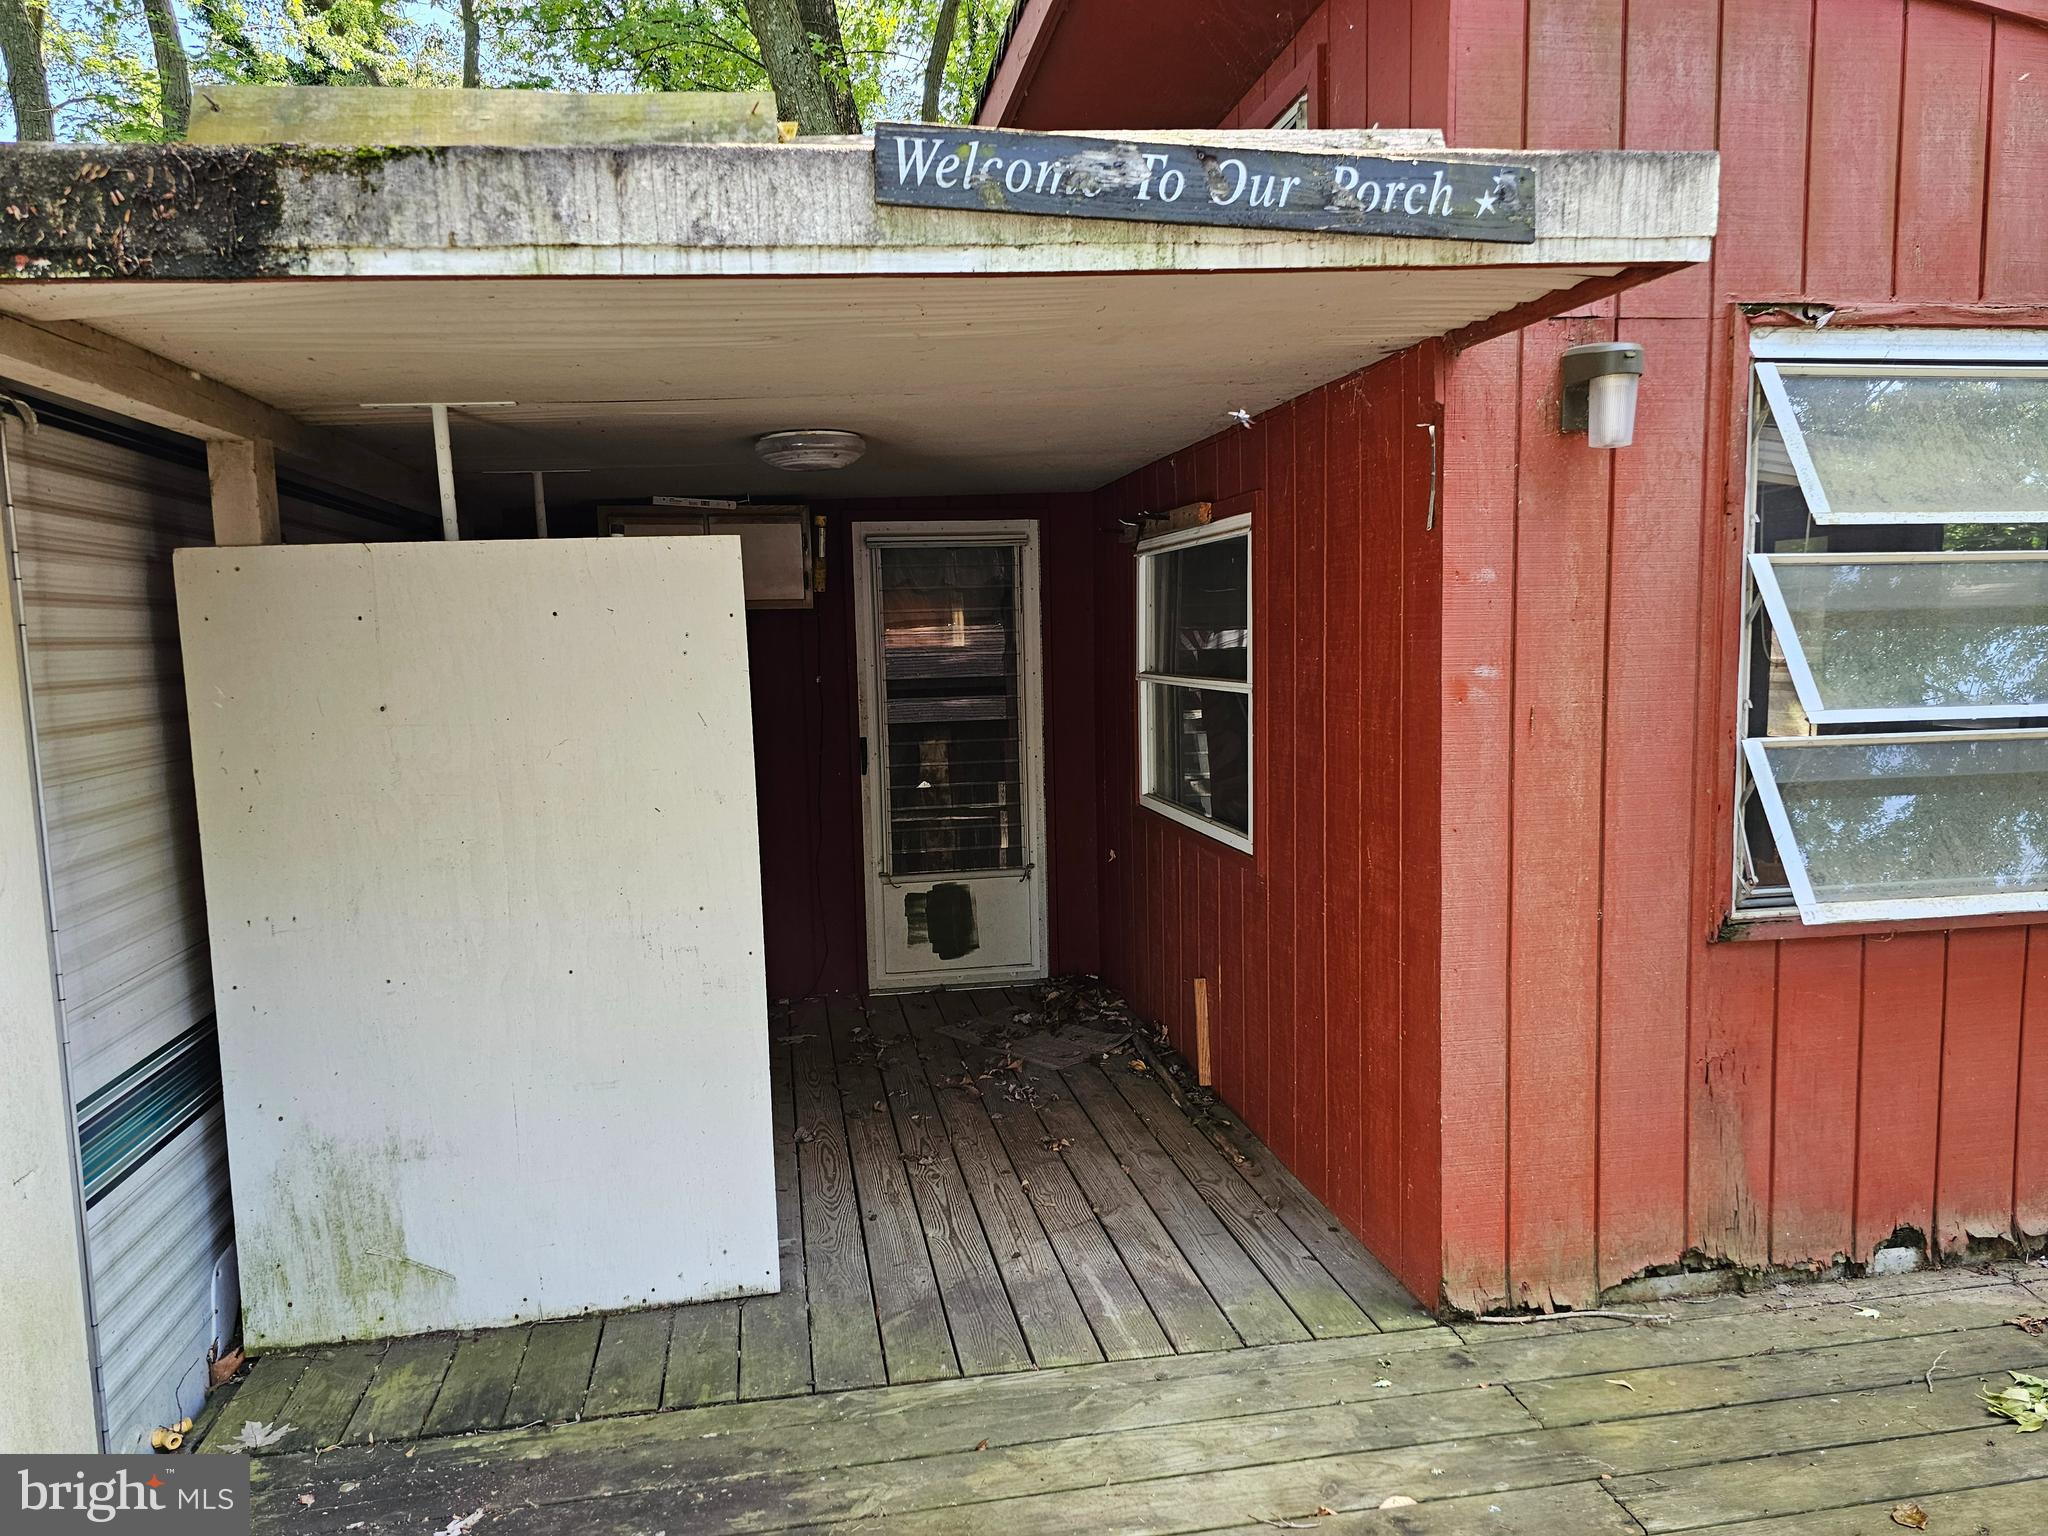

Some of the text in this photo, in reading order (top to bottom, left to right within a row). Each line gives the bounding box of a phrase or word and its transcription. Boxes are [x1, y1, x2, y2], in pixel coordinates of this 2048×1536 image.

[893, 136, 1454, 217] Welcom To Our Porch
